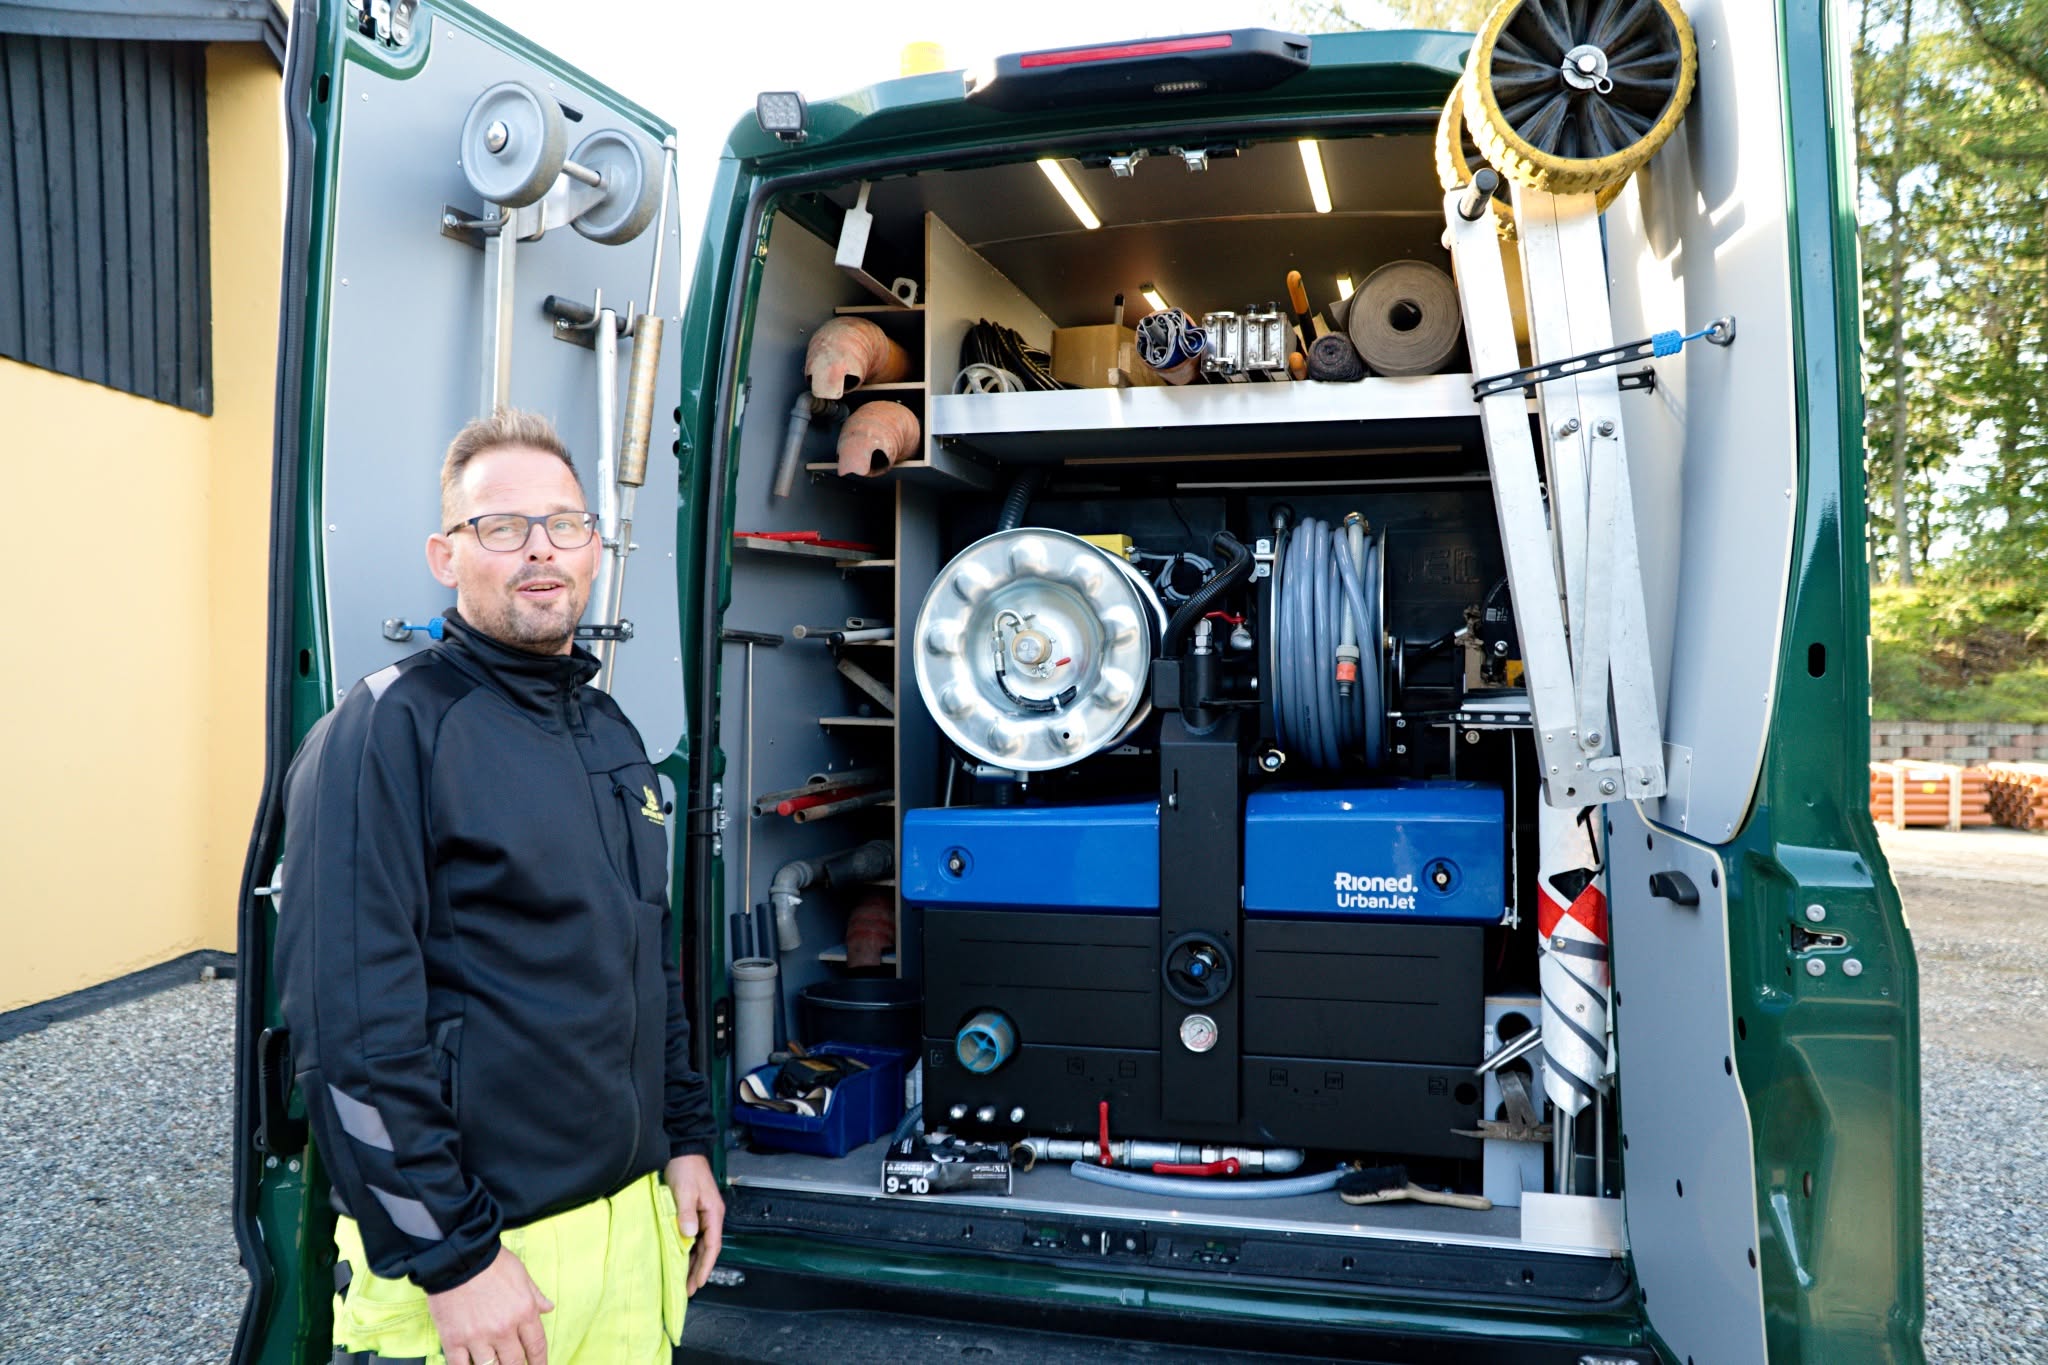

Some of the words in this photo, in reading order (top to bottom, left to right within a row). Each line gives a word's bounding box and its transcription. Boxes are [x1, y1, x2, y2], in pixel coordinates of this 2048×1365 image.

[1337, 893, 1416, 909] UrbanJet
[995, 1165, 1007, 1173] XL
[887, 1177, 929, 1194] 9-10
